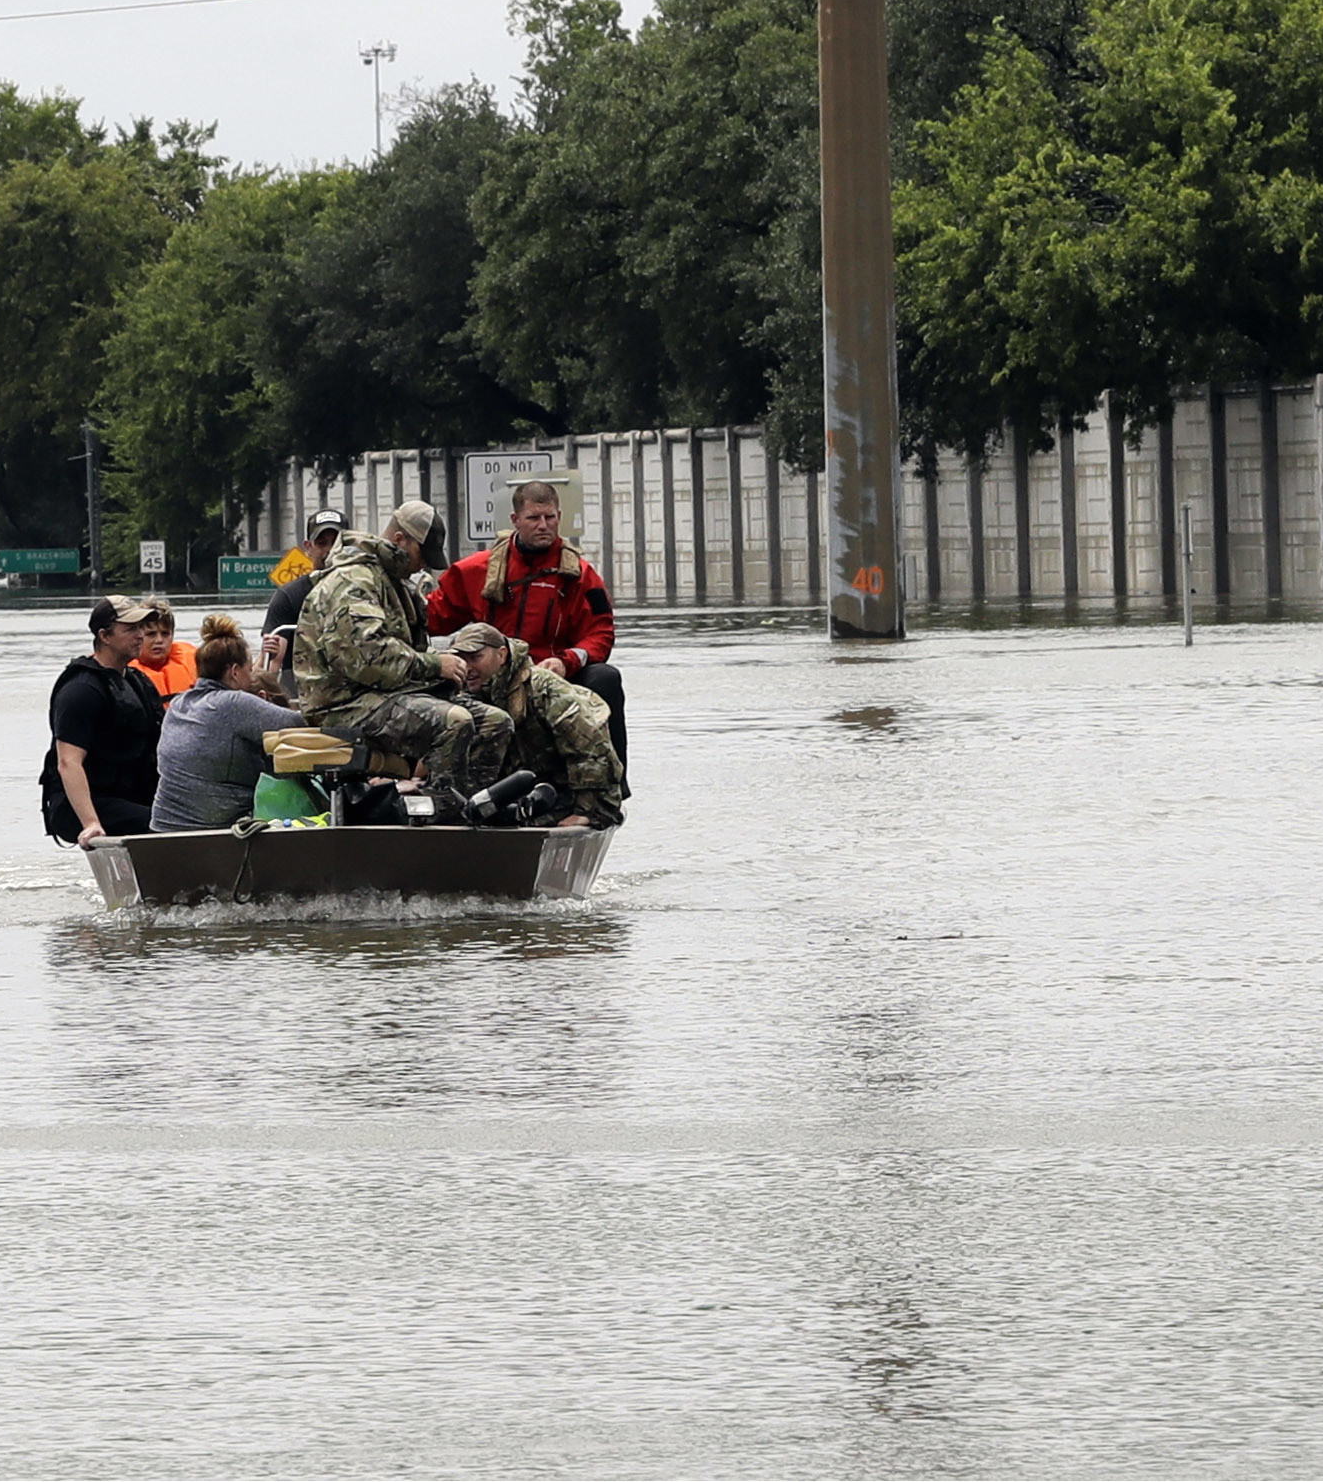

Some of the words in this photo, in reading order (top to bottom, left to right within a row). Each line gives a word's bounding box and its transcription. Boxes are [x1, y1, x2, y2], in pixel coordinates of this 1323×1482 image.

[484, 462, 501, 474] DO
[509, 460, 533, 472] NOT
[143, 557, 163, 569] 45
[222, 563, 232, 573] N
[851, 565, 884, 595] 40
